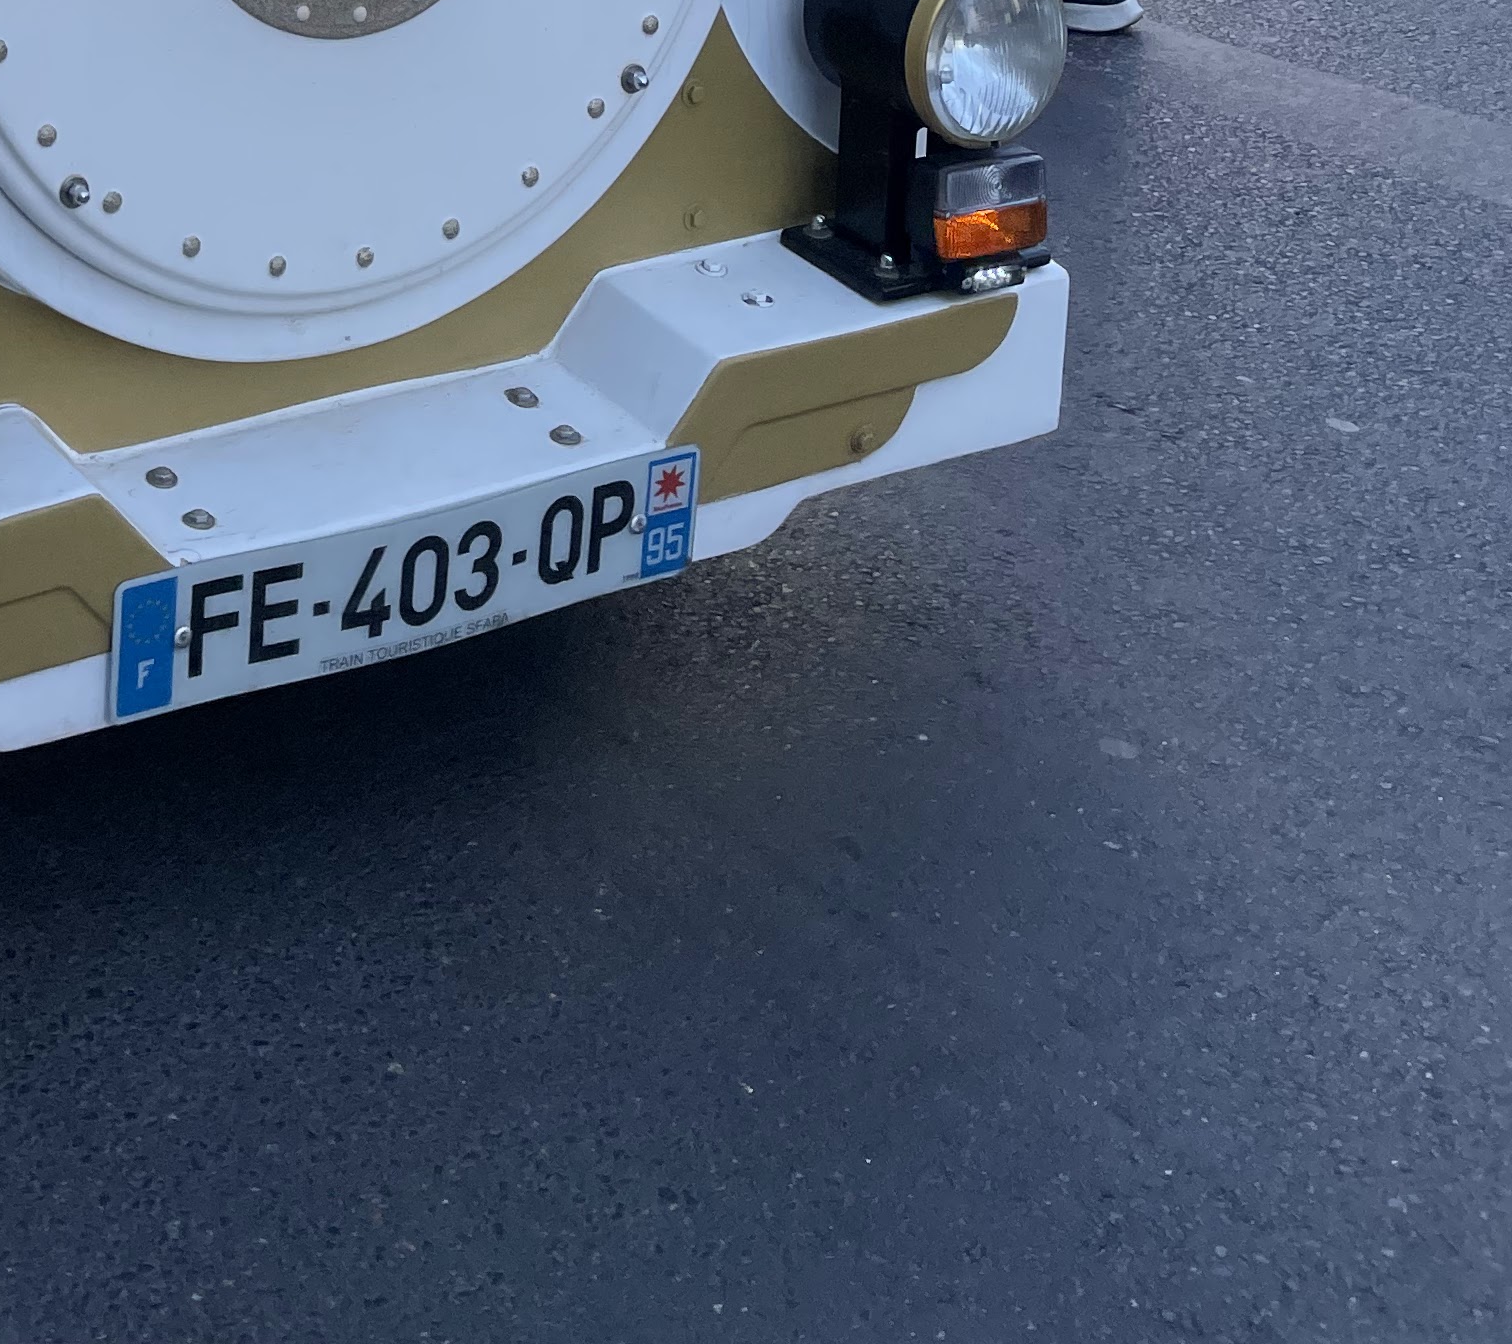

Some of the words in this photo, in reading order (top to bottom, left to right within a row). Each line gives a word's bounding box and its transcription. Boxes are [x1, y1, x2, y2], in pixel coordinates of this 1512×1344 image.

[646, 522, 685, 567] 95
[187, 479, 636, 679] FE-403-QP
[320, 652, 364, 673] TRAIN
[368, 628, 464, 660] TOURISTIQUE
[466, 613, 510, 636] SFAPA
[136, 658, 156, 691] F
